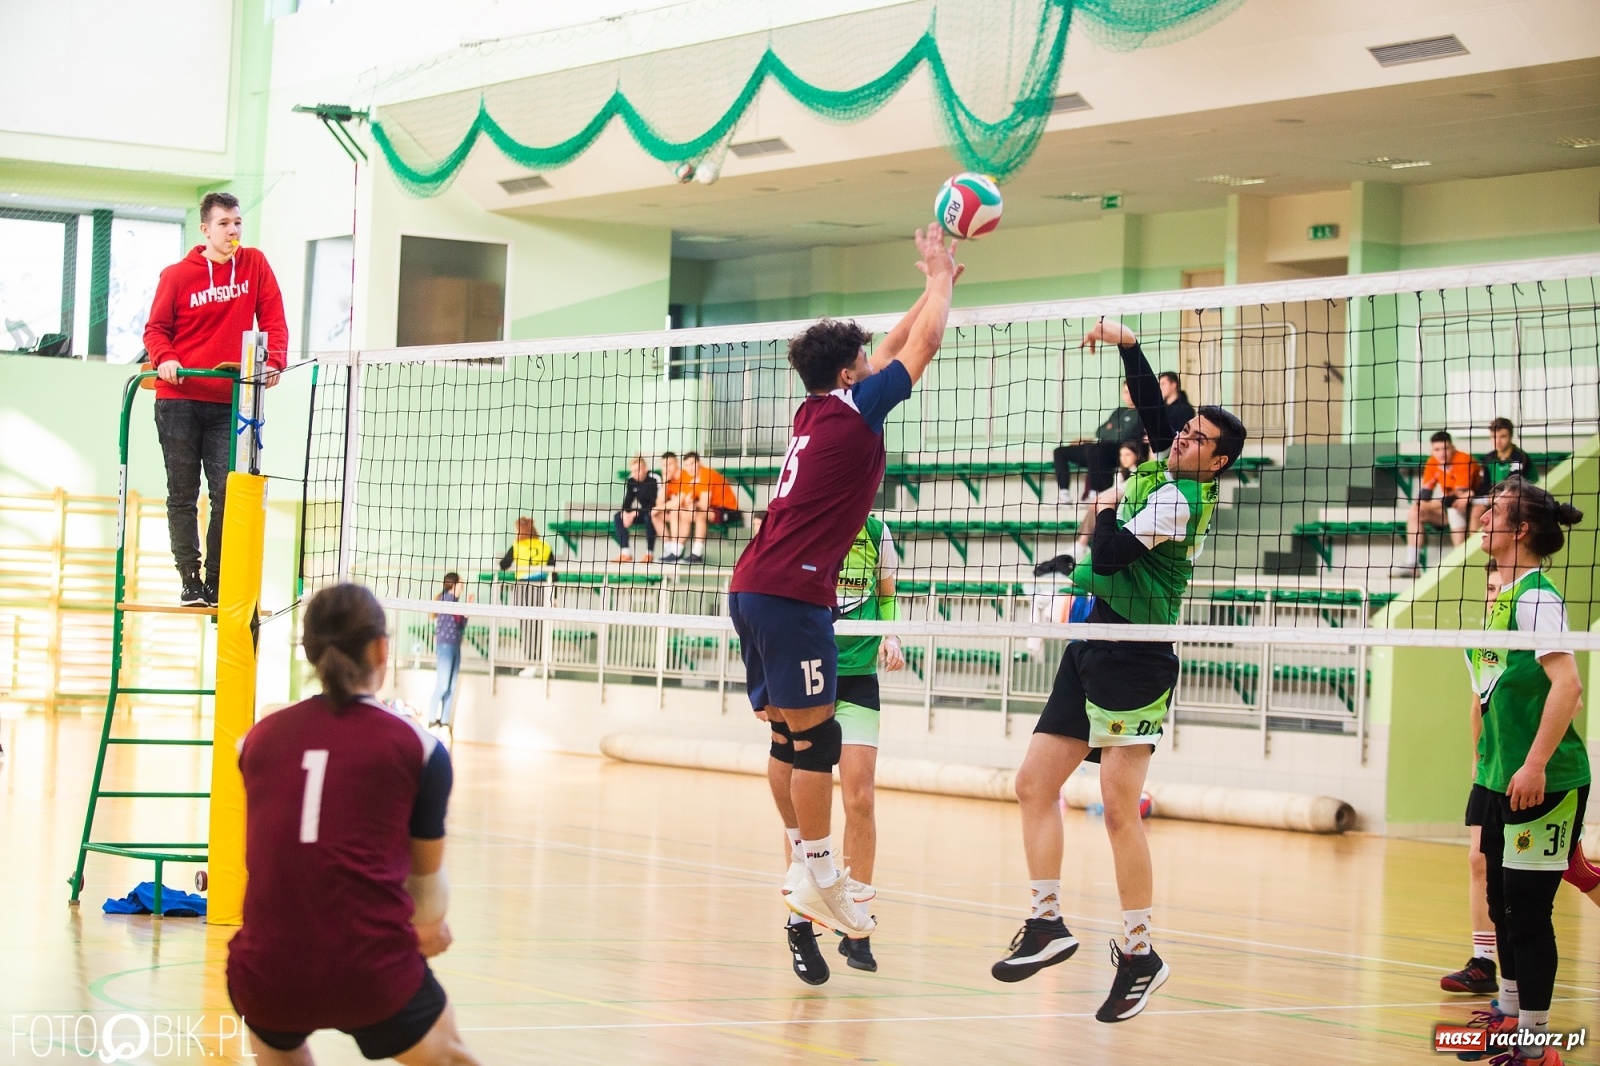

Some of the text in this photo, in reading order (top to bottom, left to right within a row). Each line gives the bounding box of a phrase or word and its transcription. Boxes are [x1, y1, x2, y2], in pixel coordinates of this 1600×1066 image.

[773, 435, 811, 499] 15
[800, 658, 825, 696] 15
[300, 749, 329, 843] 1
[806, 850, 830, 859] FILA
[1543, 823, 1560, 856] 3
